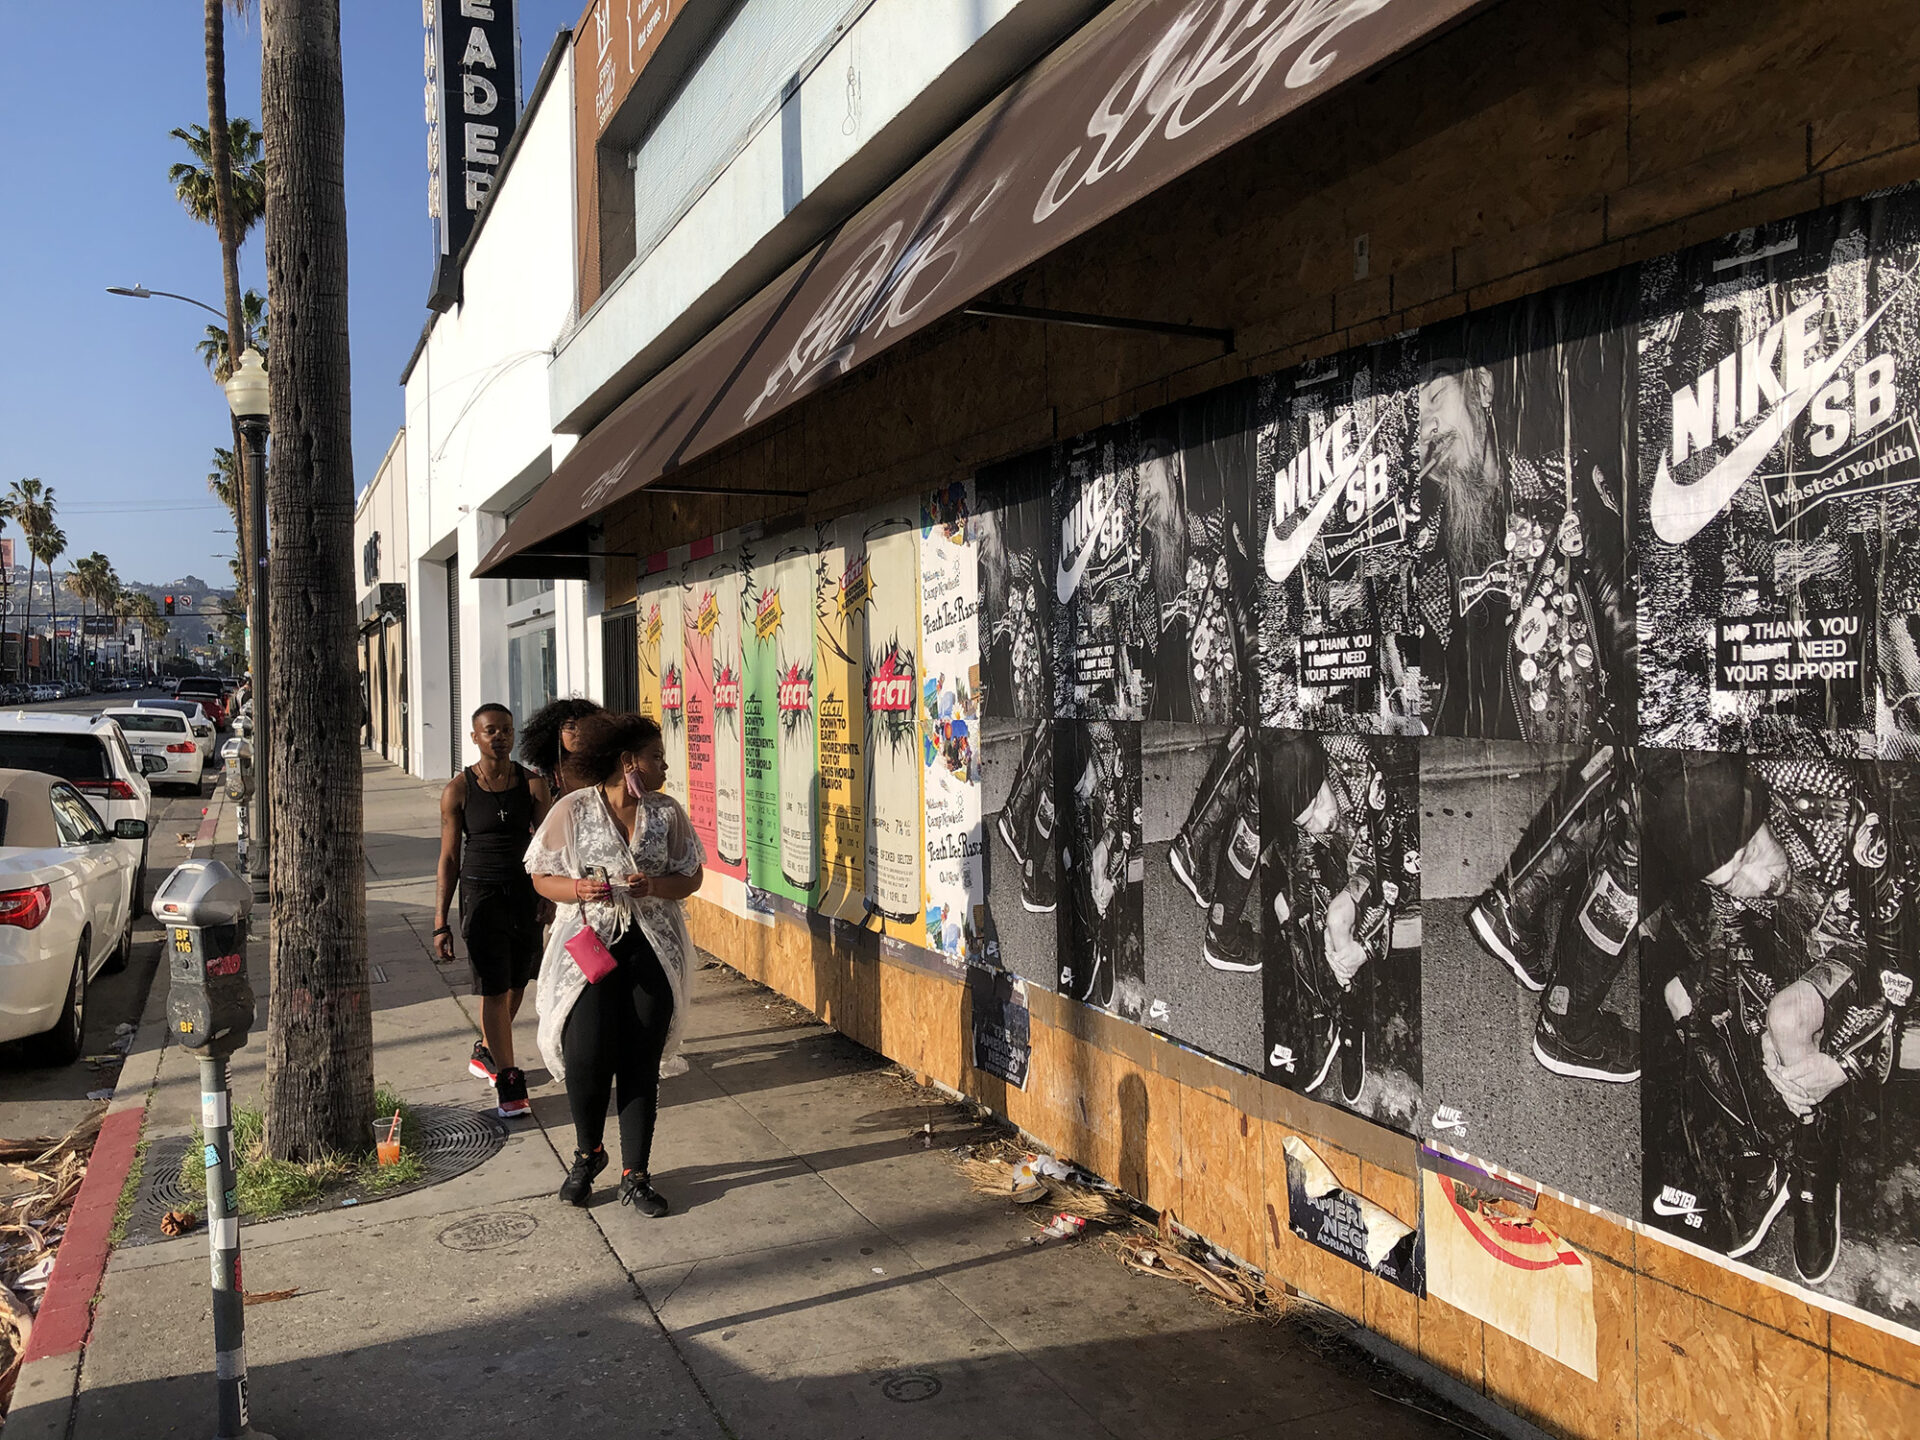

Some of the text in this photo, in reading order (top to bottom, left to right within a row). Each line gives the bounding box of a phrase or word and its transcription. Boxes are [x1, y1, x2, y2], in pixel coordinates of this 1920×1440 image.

[1672, 294, 1826, 467] NIKE
[1810, 353, 1896, 458] SB
[1275, 408, 1356, 527] NIKE
[1771, 444, 1917, 508] Wasted Youth
[1346, 452, 1388, 523] SB
[1062, 476, 1104, 559] NIKE
[1100, 507, 1124, 561] SB
[1326, 515, 1398, 560] Wasted Youth
[1752, 620, 1812, 640] THANK
[1819, 616, 1859, 637] YOU
[1104, 645, 1114, 656] YOU
[1318, 636, 1350, 652] THANK
[1352, 634, 1372, 648] YOU
[1732, 645, 1738, 662] I
[1798, 640, 1847, 659] NEED
[1098, 656, 1112, 668] NEED
[1308, 655, 1312, 667] I
[1342, 650, 1367, 665] NEED
[1078, 668, 1116, 681] YOUR SUPPORT
[1304, 665, 1372, 682] YOUR SUPPORT
[1723, 661, 1858, 682] YOUR SUPPORT
[662, 687, 681, 706] CACTI
[715, 685, 737, 704] CACTI
[780, 683, 808, 707] CACTI
[870, 681, 911, 706] CACTI
[820, 700, 844, 717] CACTI
[820, 718, 846, 730] DOWN TO
[820, 730, 838, 740] EARTH
[820, 754, 832, 765] OUT
[821, 766, 855, 780] THIS WORLD
[822, 778, 842, 791] FLAVOR
[176, 928, 190, 940] BF
[176, 941, 192, 953] 116
[1883, 974, 1912, 993] UPRIGHT
[1438, 1104, 1462, 1122] NIKE
[1454, 1126, 1467, 1138] SB
[1661, 1184, 1697, 1209] WASTED
[1684, 1212, 1703, 1228] SB
[1316, 1232, 1354, 1257] ADRIAN
